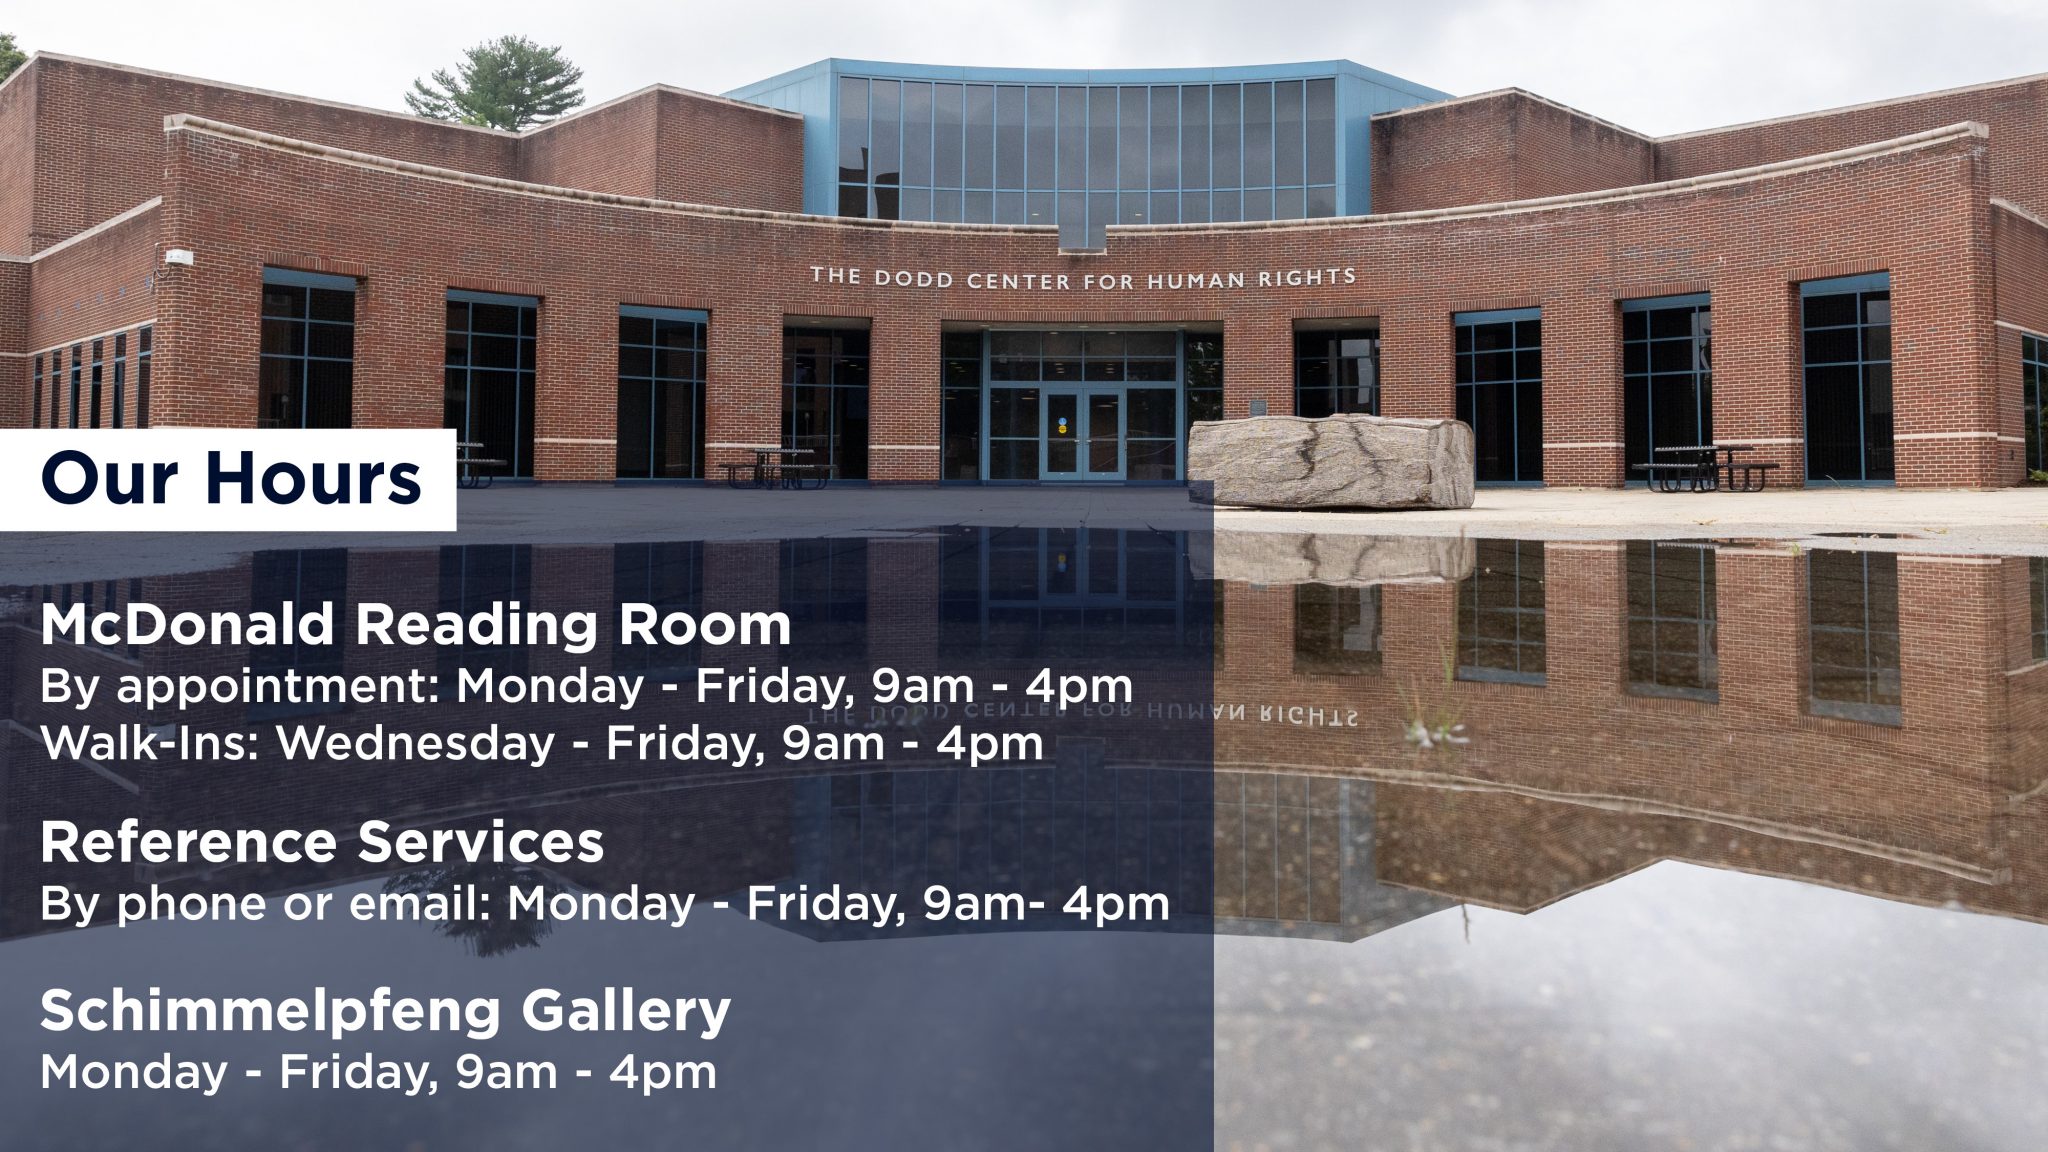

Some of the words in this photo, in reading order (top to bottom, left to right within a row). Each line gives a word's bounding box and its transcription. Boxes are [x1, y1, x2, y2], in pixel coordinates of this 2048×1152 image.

[810, 266, 860, 285] THE
[875, 270, 953, 288] DODD
[967, 274, 1070, 290] CENTER
[1084, 274, 1134, 290] FOR
[1148, 272, 1244, 290] HUMAN
[1259, 268, 1356, 287] RIGHTS
